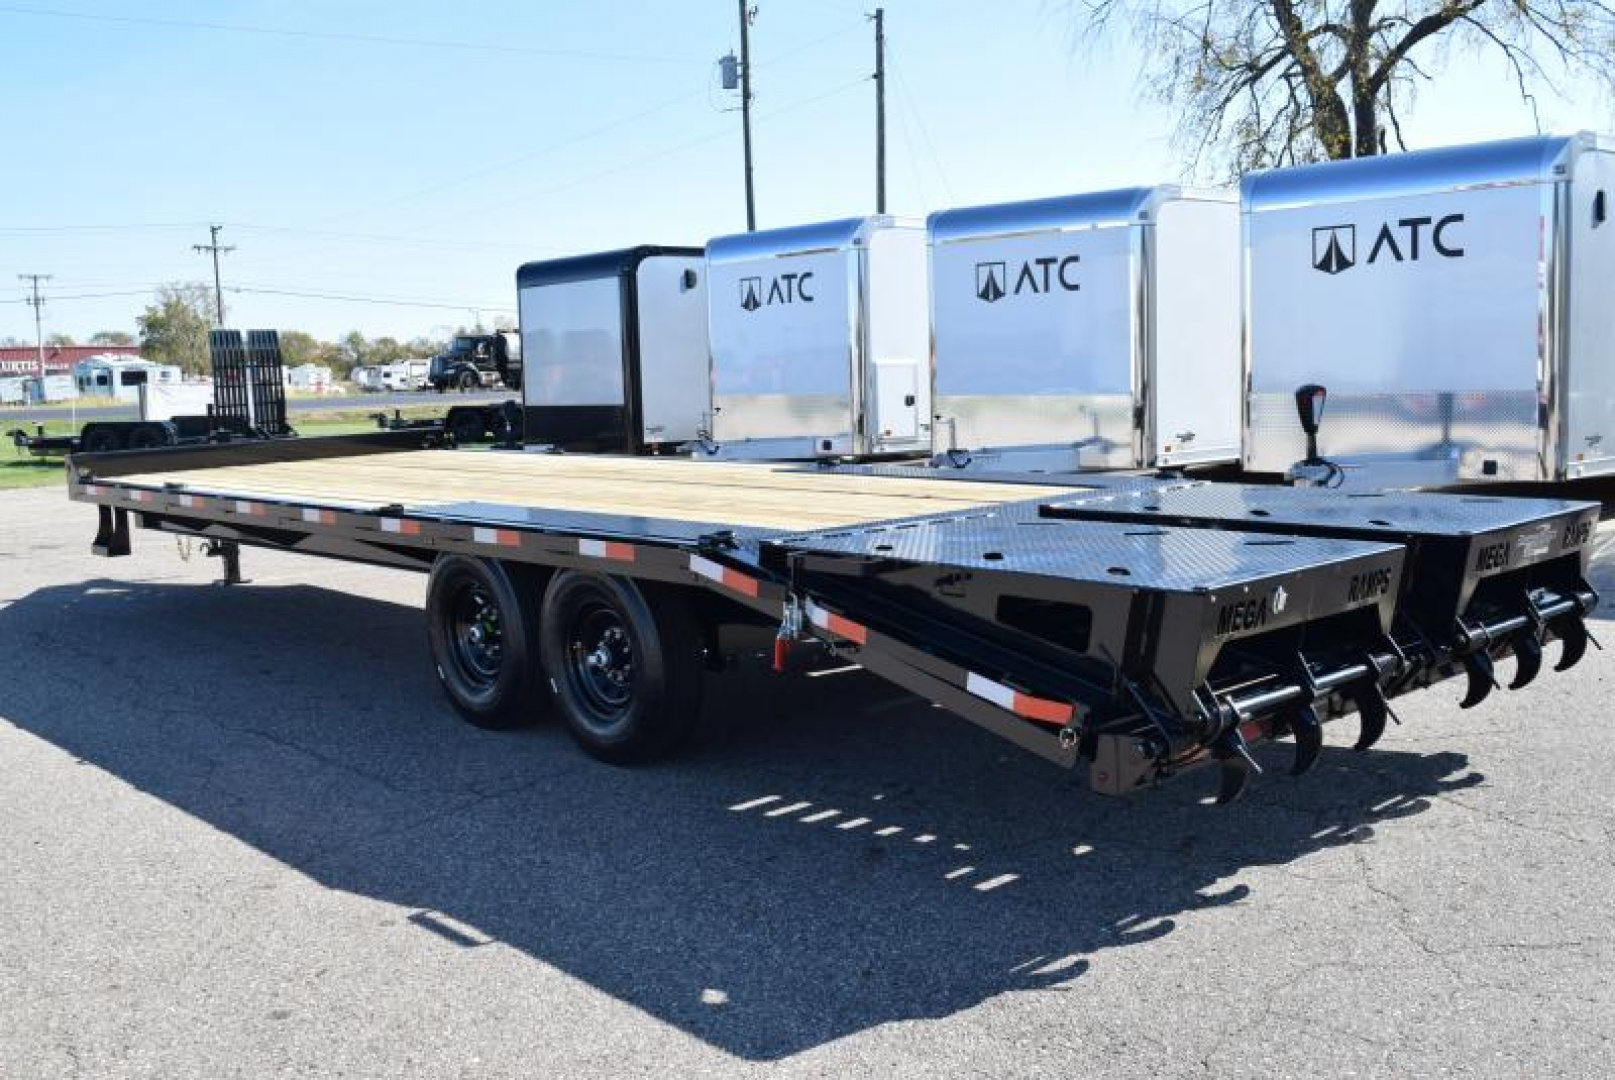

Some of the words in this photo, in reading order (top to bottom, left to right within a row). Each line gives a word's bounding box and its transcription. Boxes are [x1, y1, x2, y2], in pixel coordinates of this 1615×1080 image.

[1366, 203, 1465, 264] ATC
[766, 272, 815, 305] ATC
[1013, 255, 1081, 295] ATC
[1476, 541, 1509, 572] MEGA
[1217, 597, 1267, 636] MEGA
[1348, 568, 1393, 603] RAMPS
